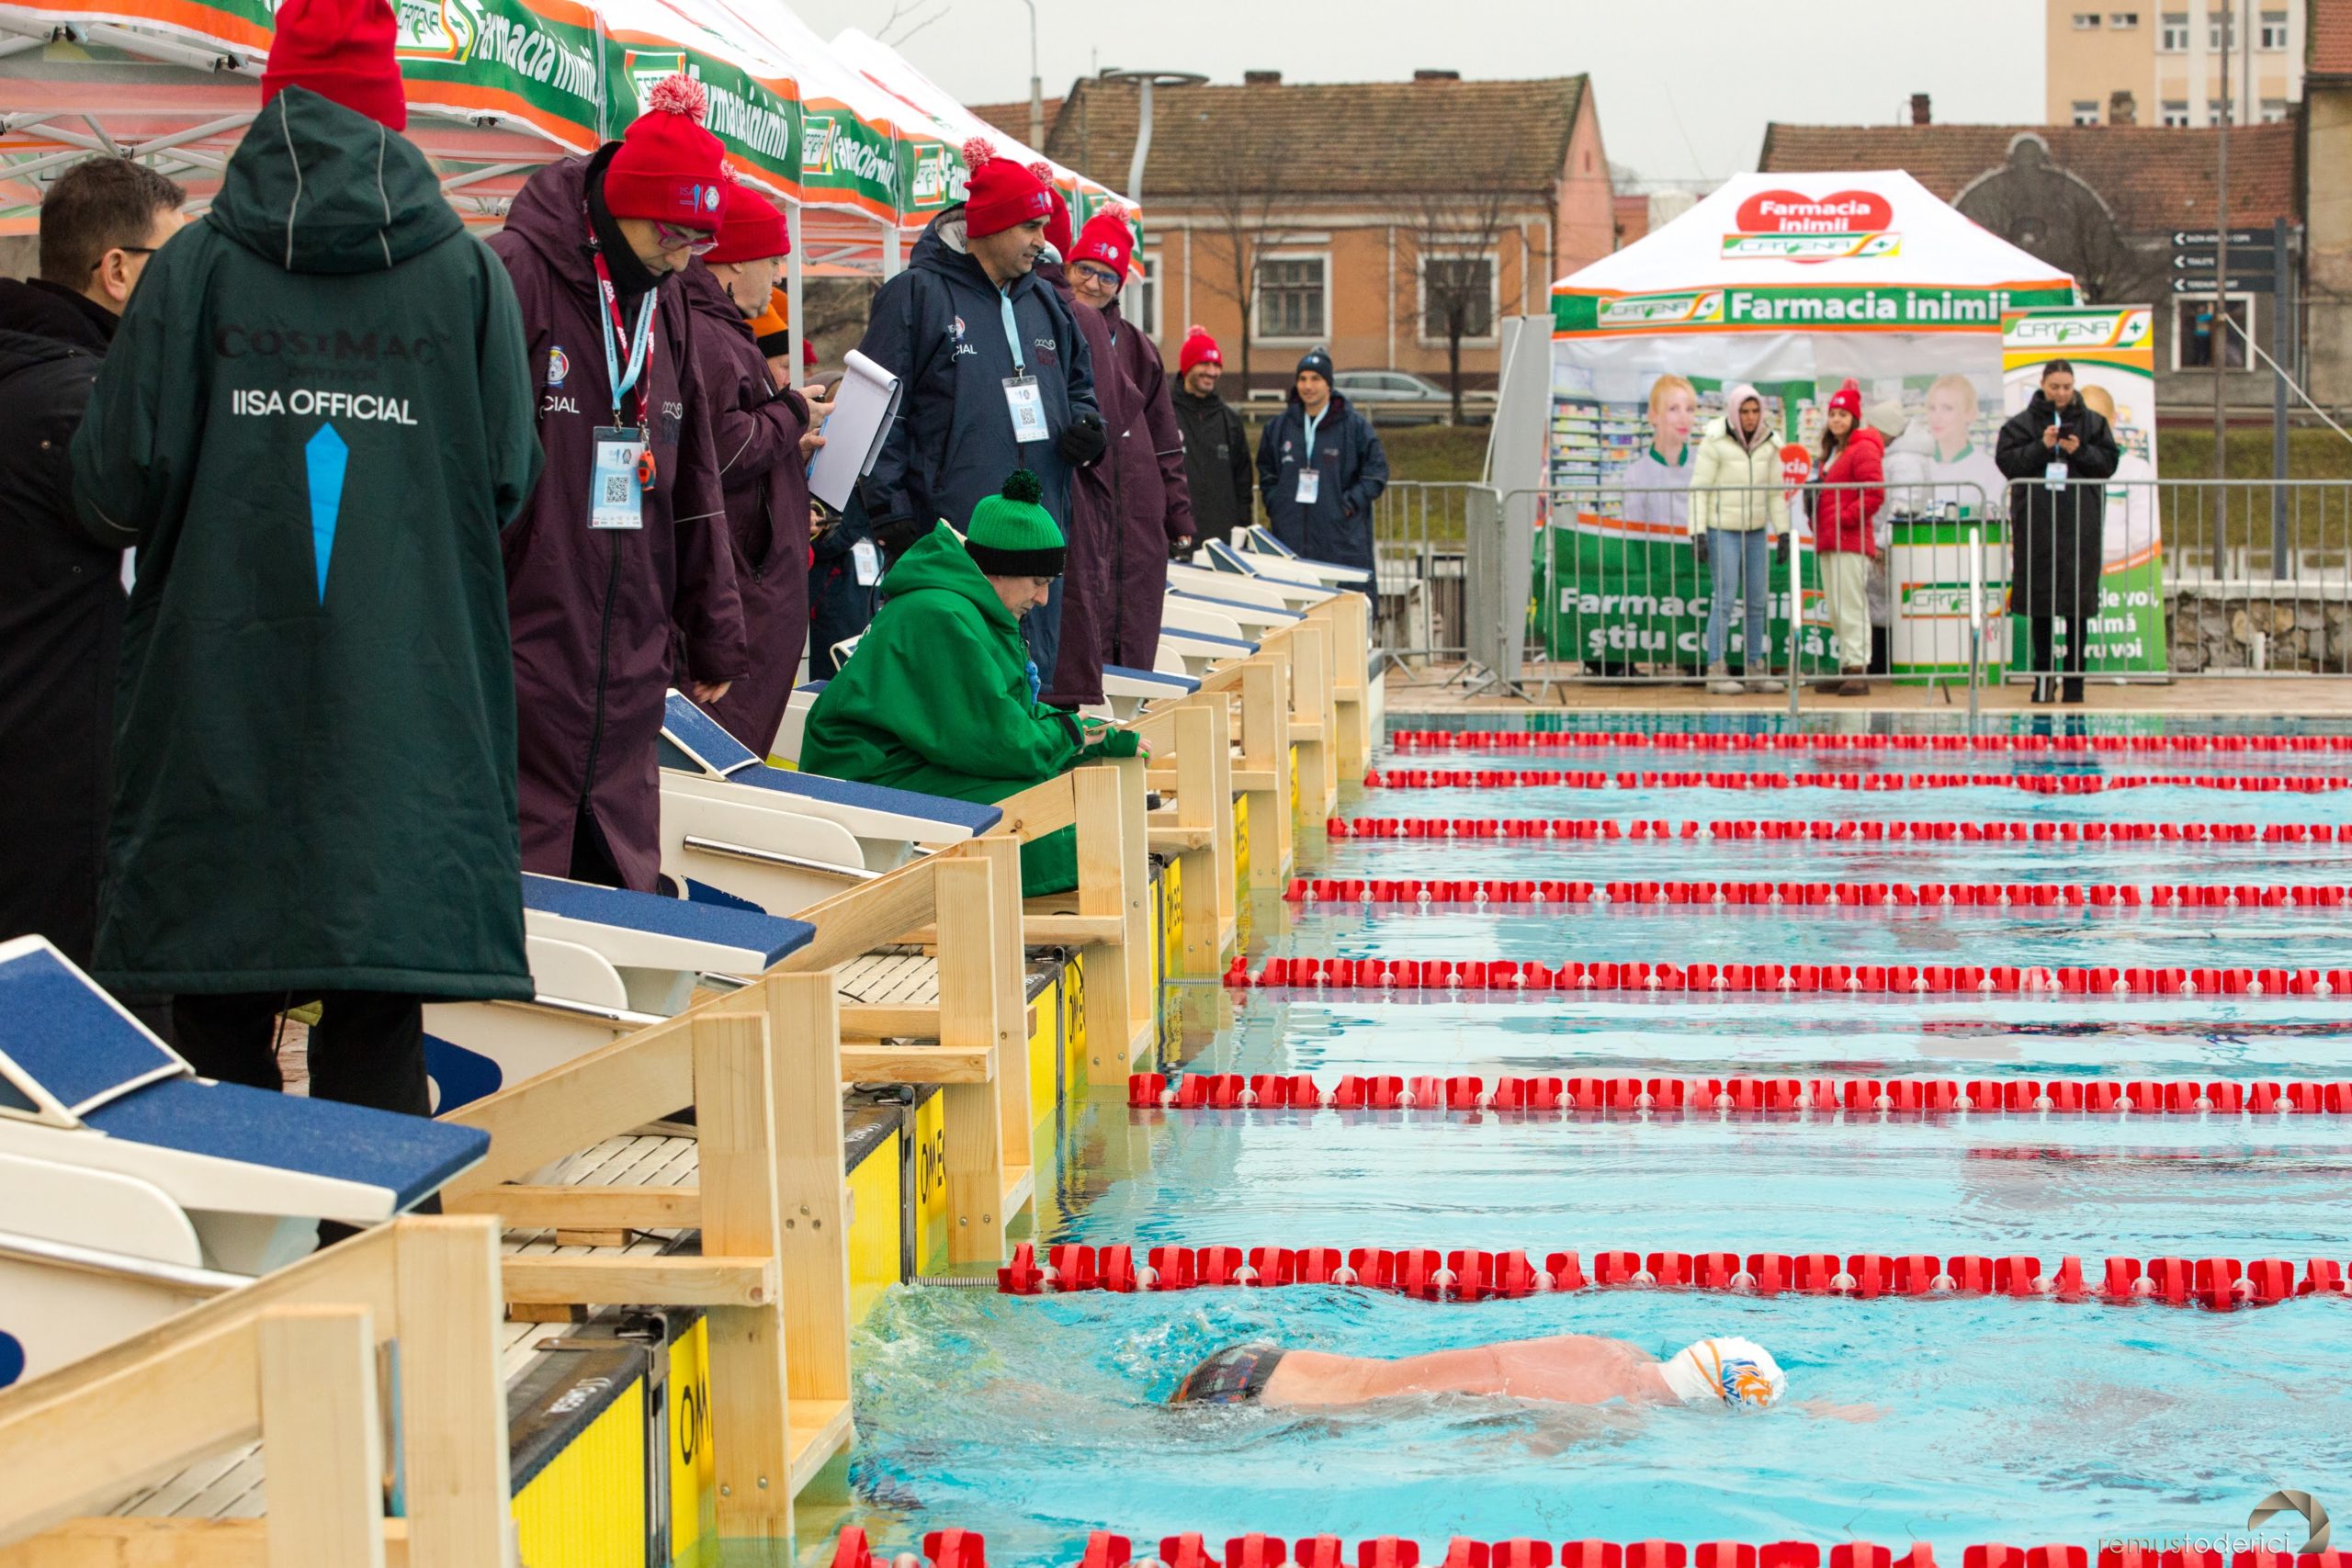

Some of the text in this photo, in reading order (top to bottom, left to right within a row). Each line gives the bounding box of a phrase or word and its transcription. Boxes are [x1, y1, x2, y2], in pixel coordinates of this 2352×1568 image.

[1759, 199, 1871, 216] Farmacia
[1779, 217, 1849, 231] inimii
[1610, 301, 1689, 317] CATENA
[1732, 291, 1897, 320] Farmacia
[2016, 321, 2110, 343] CATENA
[232, 389, 418, 425] IISA OFFICIAL
